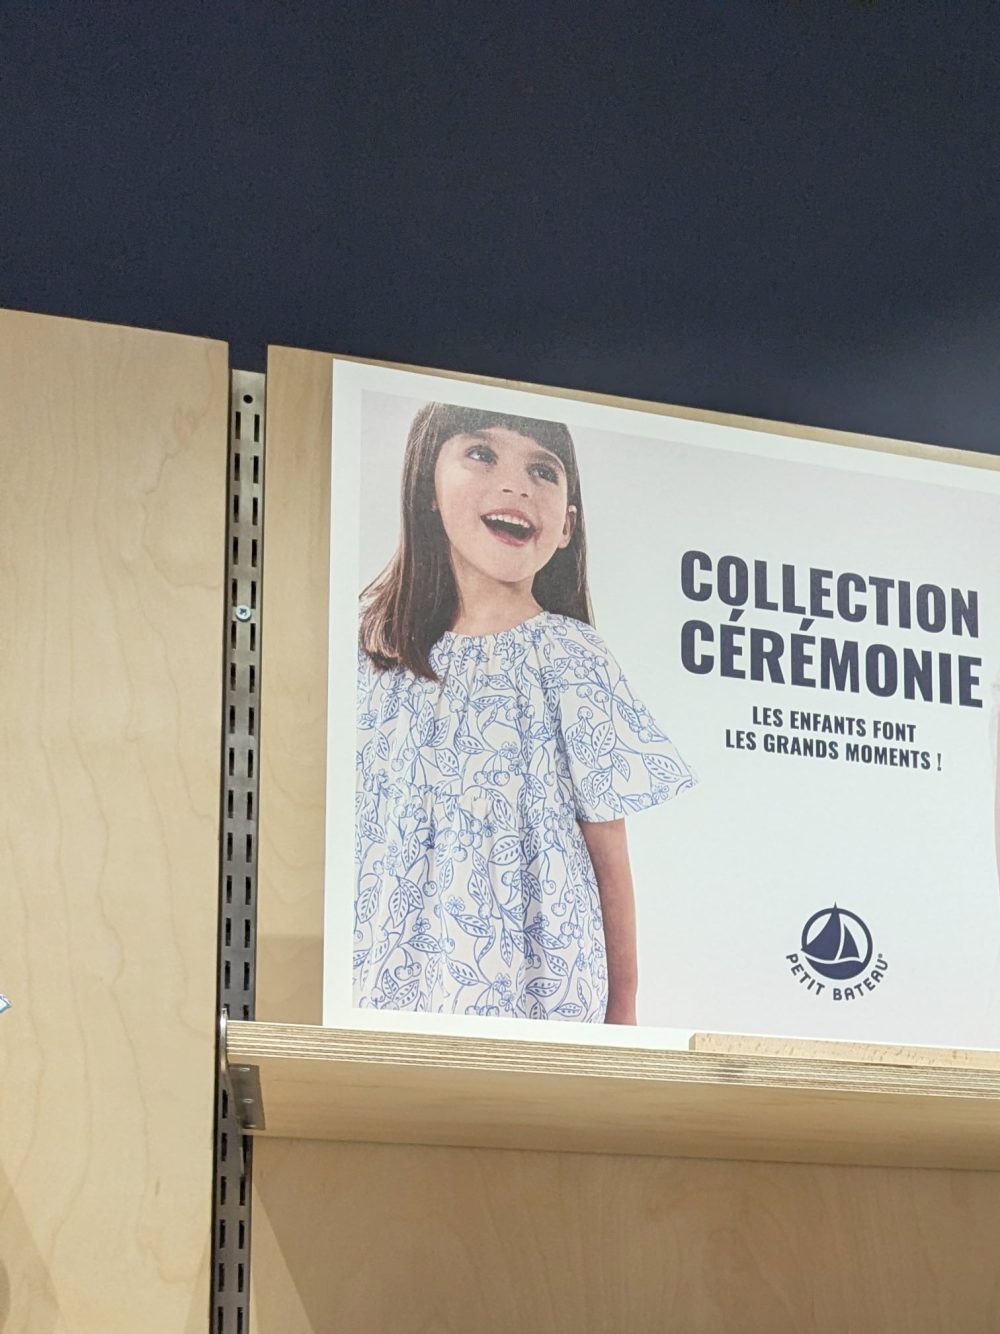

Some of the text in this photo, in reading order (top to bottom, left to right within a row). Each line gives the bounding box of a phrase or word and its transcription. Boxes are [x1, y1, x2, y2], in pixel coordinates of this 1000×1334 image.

[681, 550, 979, 638] COLLECTION
[681, 609, 983, 708] CÉRÉMONIE
[752, 706, 916, 743] LES ENFANTS FONT
[725, 729, 757, 750] LES
[763, 733, 839, 760] GRANDS
[845, 744, 930, 771] MOMENTS
[786, 953, 888, 1001] PETIT BATEAU
